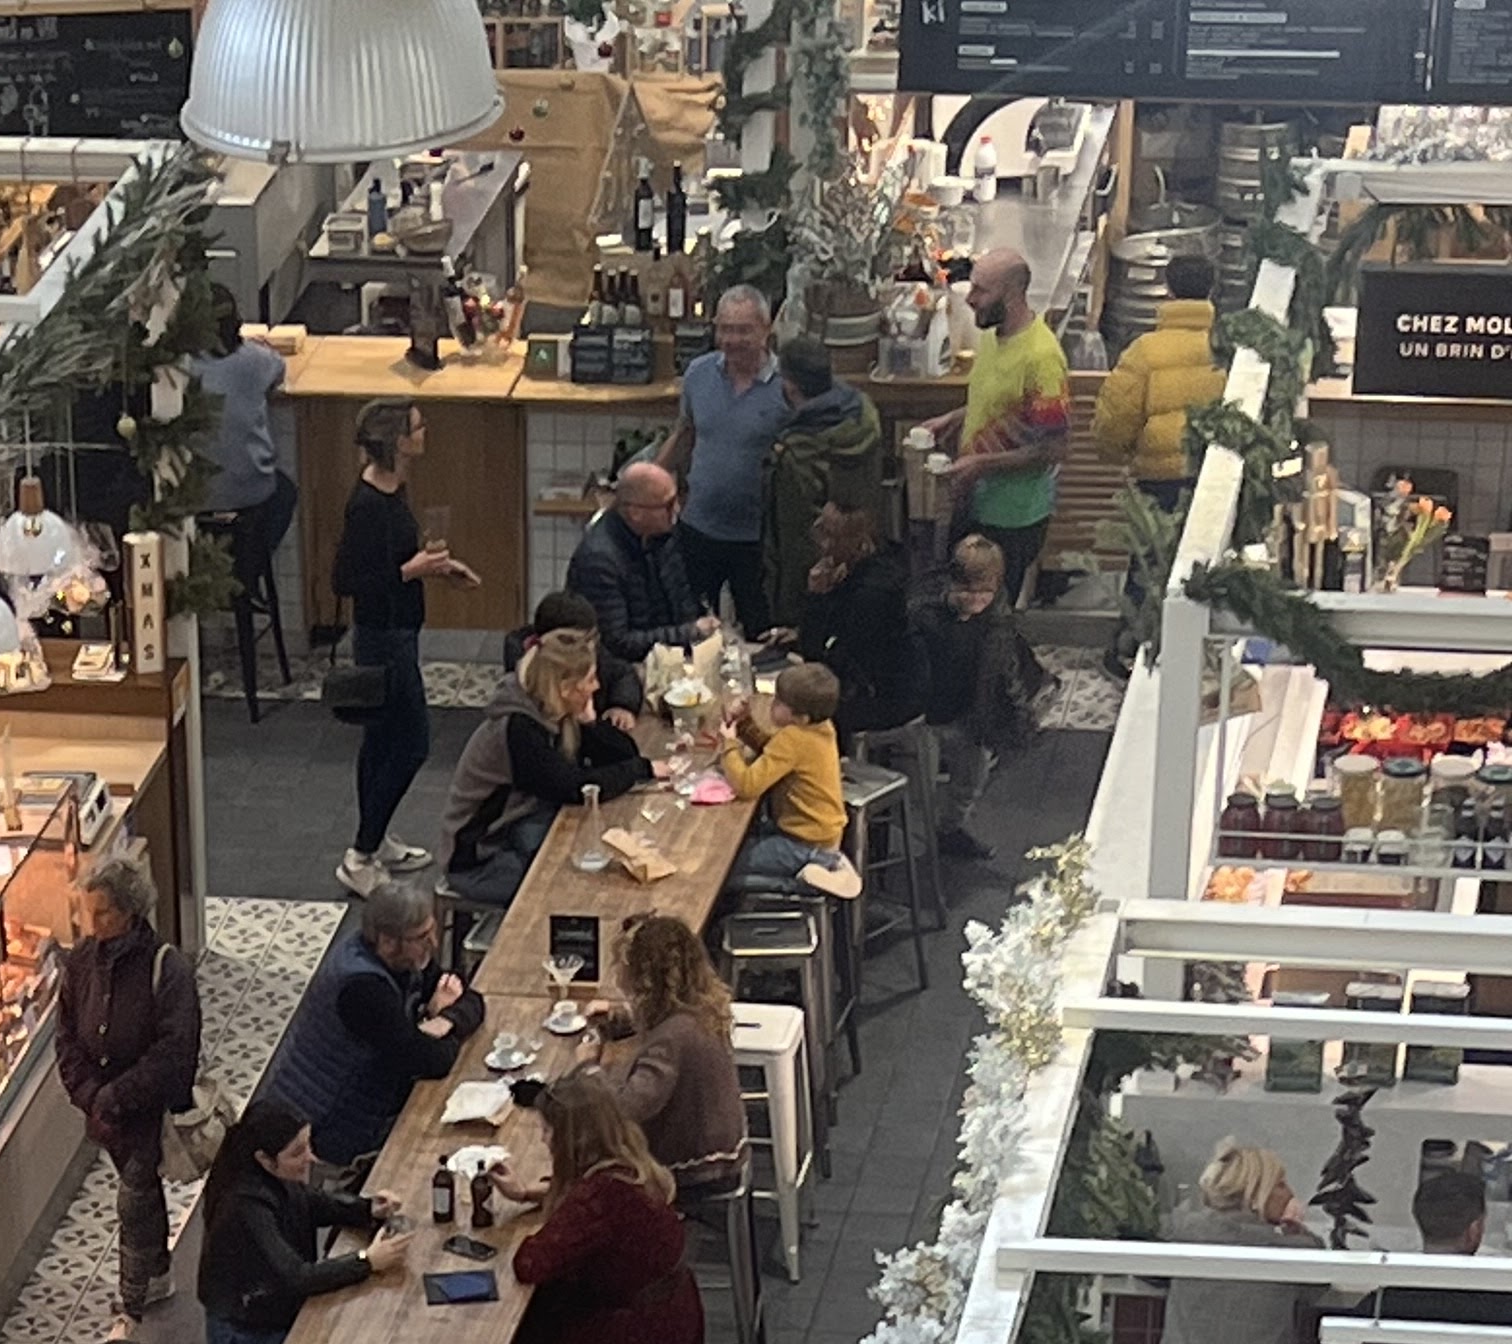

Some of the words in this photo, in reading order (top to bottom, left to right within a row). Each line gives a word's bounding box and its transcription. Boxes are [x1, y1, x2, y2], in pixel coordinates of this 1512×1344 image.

[1397, 313, 1459, 334] CHEZ
[1399, 341, 1429, 358] UN
[1435, 342, 1484, 360] BRIN
